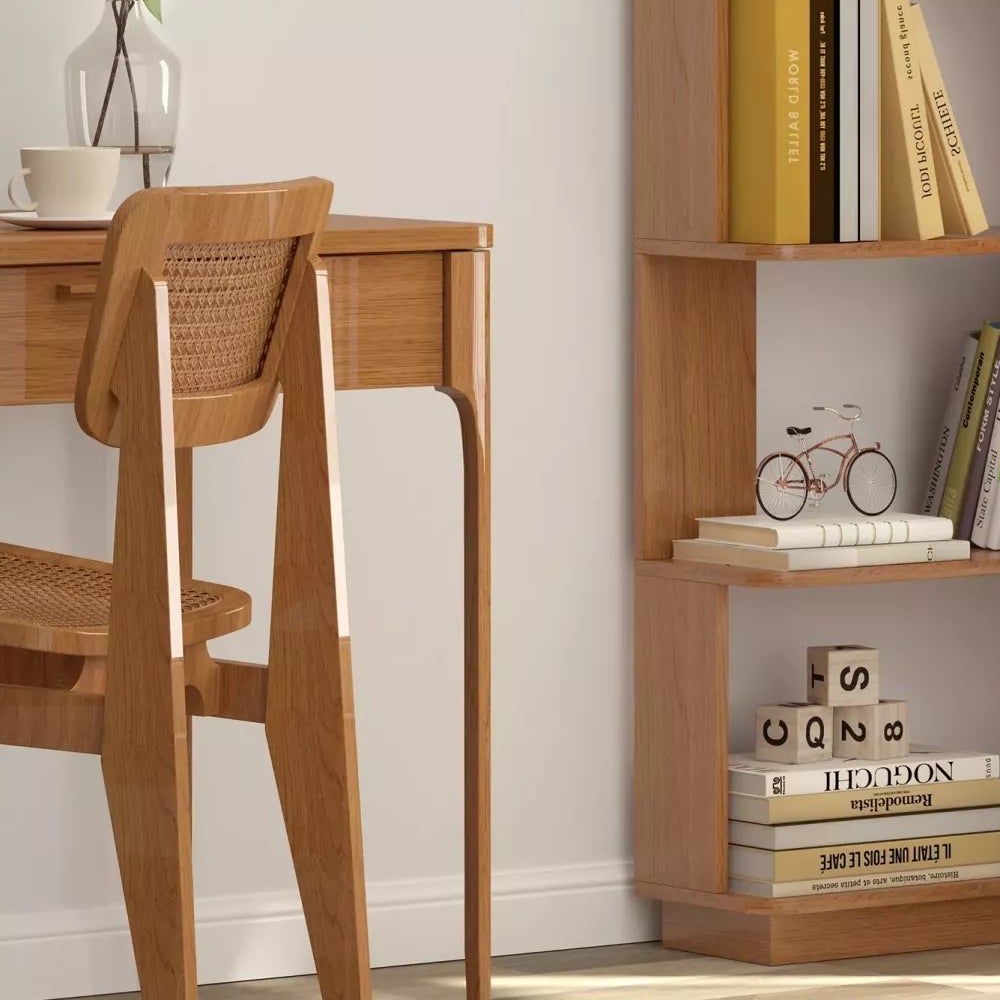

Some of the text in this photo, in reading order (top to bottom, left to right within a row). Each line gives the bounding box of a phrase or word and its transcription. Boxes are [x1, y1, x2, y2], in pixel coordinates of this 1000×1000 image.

[976, 360, 1000, 452] FORM STYLE
[924, 426, 950, 513] WASHINGTON
[976, 499, 988, 528] State
[984, 449, 998, 493] Capital
[811, 663, 825, 689] T
[840, 665, 869, 692] S
[763, 718, 788, 746] C
[805, 716, 825, 749] Q
[841, 719, 866, 742] 2
[884, 720, 904, 742] 8
[824, 761, 954, 792] NOGUCHI
[850, 793, 933, 812] Remodelista
[820, 843, 952, 874] IL ÉTAIT UNE FOIS LE CAFÉ
[812, 883, 839, 891] secrets
[840, 880, 861, 889] petits
[889, 874, 927, 885] botanique,
[928, 871, 959, 880] Histoire,
